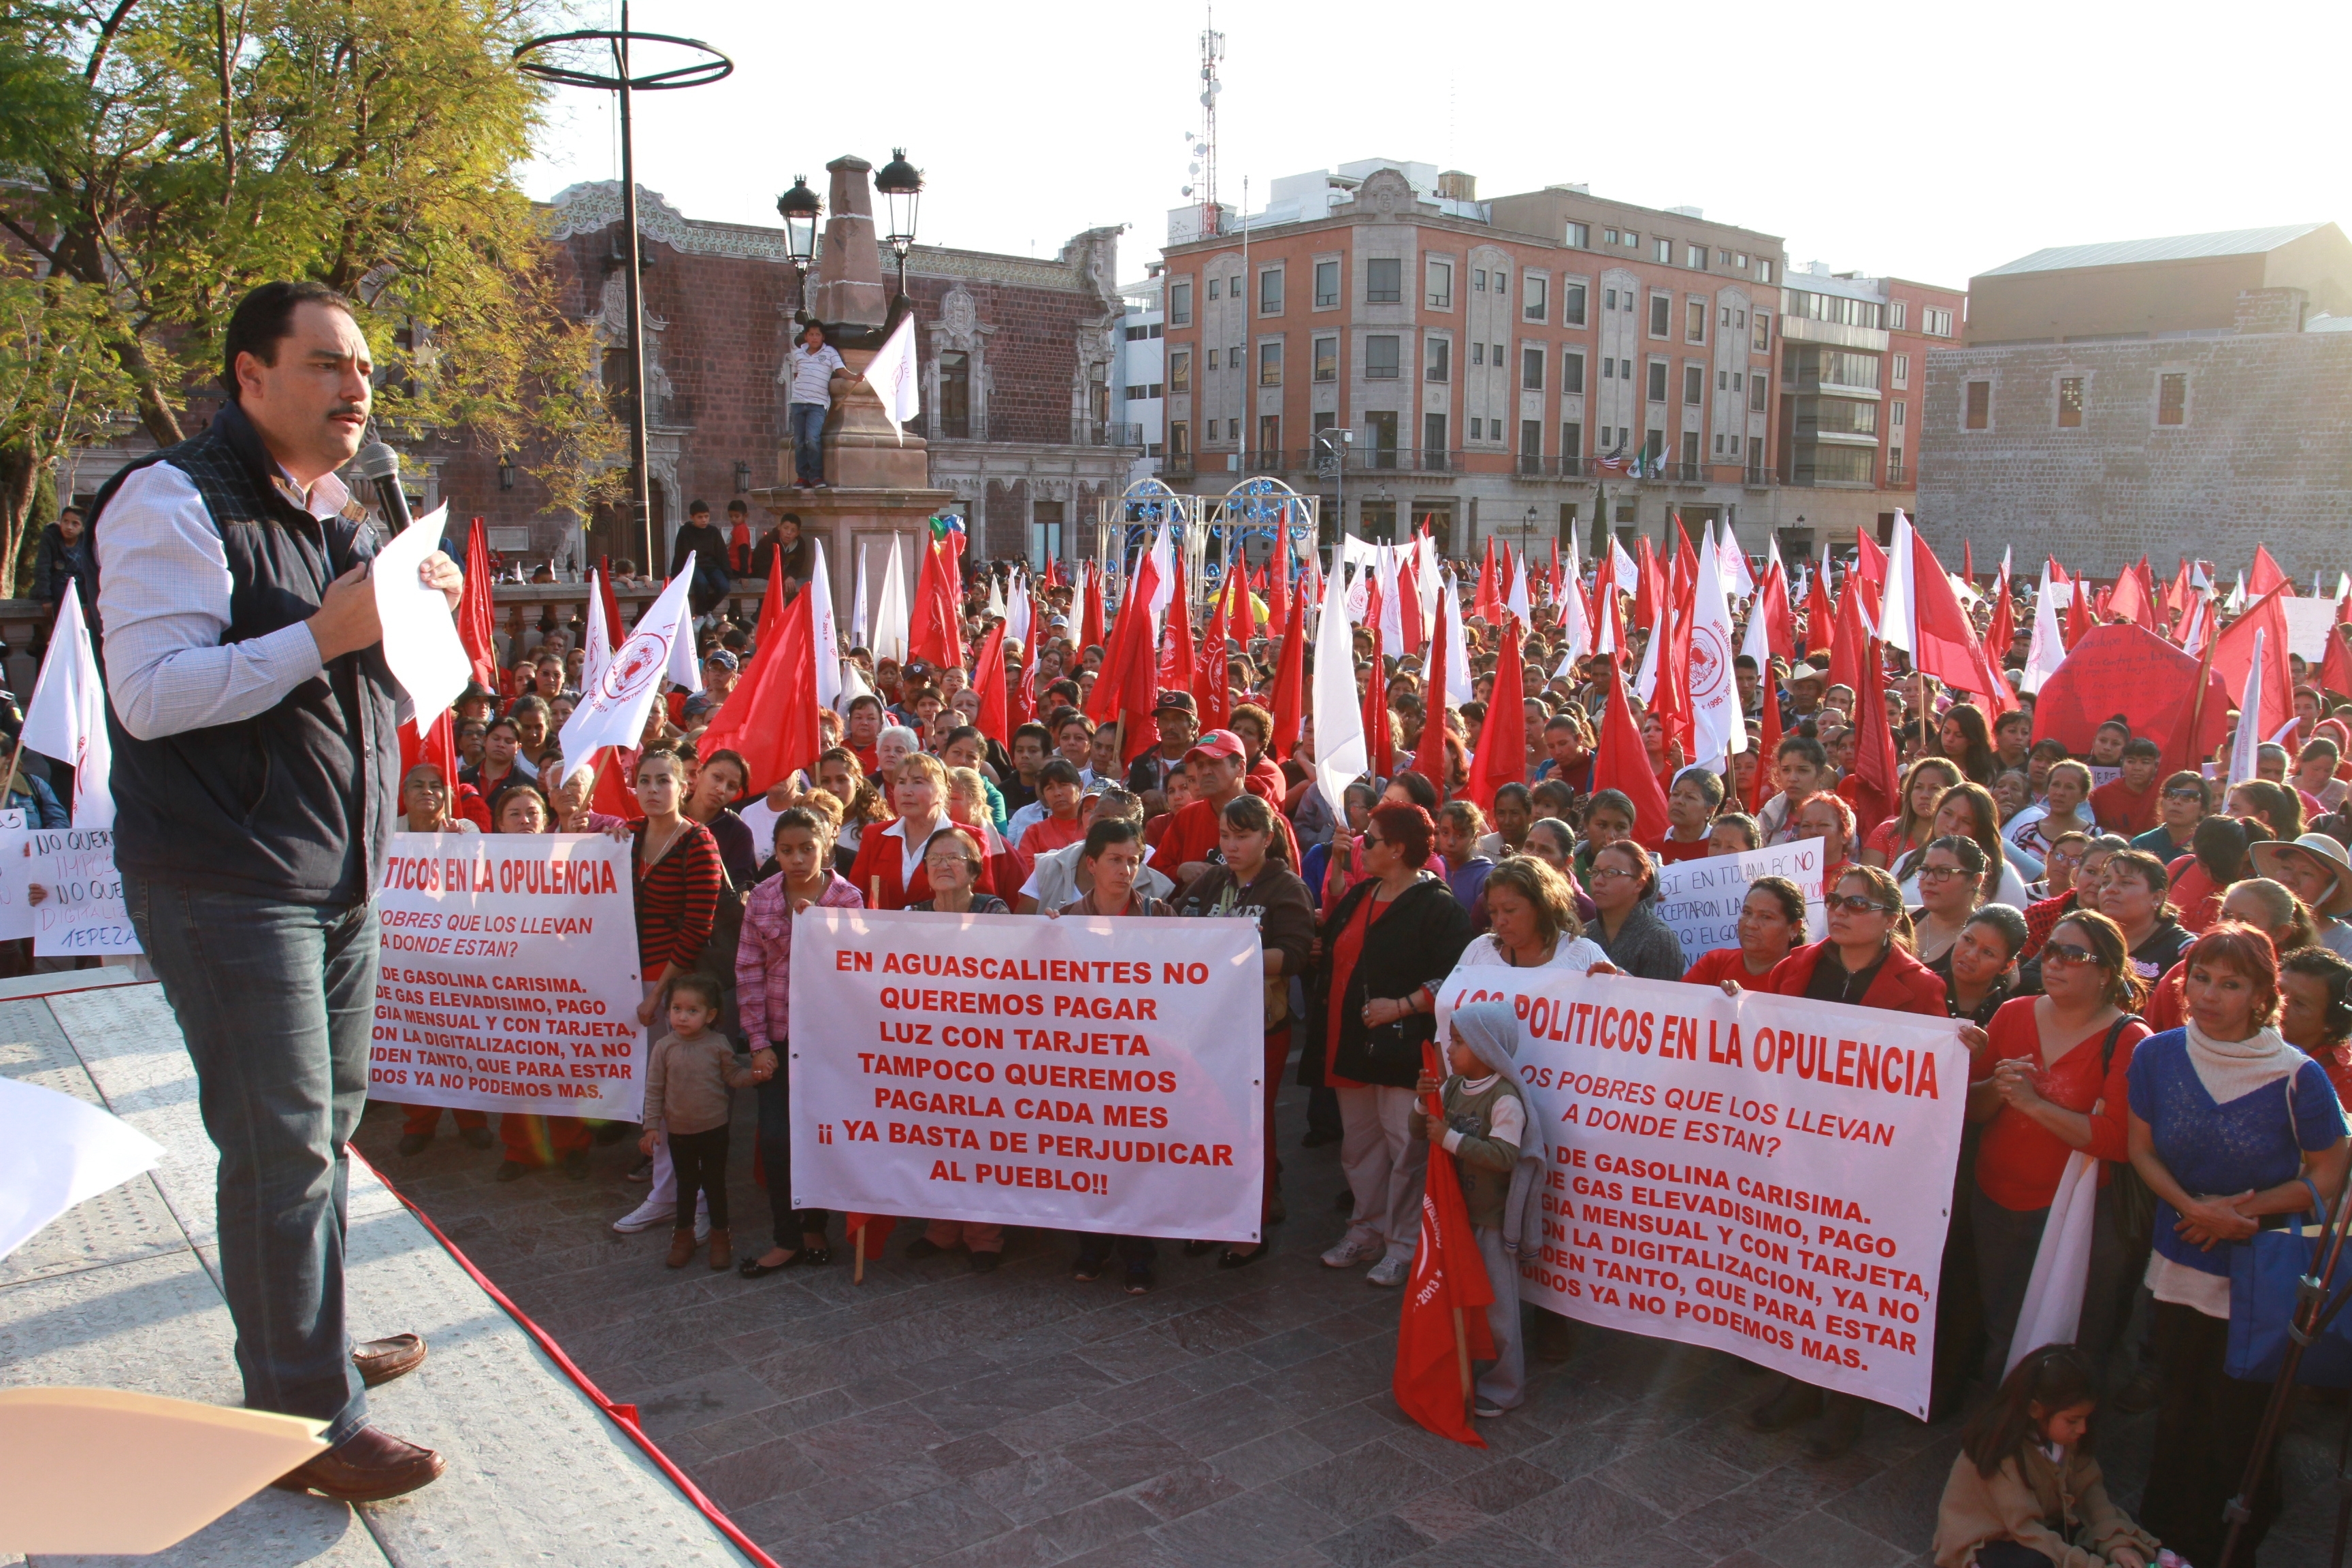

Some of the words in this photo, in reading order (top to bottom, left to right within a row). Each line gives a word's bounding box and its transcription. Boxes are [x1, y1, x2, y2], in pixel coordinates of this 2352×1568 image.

[36, 833, 61, 855] NO
[446, 859, 467, 892] EN
[472, 860, 495, 892] LA
[500, 860, 617, 895] OPULENCIA
[1660, 873, 1682, 896] SI
[1692, 869, 1714, 889] EN
[1795, 851, 1814, 873] NO
[56, 882, 84, 904] NO
[1656, 899, 1720, 921] ACEPTARON
[1726, 897, 1742, 916] LA
[378, 910, 442, 929] OBRES
[447, 914, 480, 932] QUE
[485, 915, 517, 933] LOS
[521, 917, 593, 934] LLEVAN
[380, 933, 389, 948] A
[393, 934, 452, 954] DONDE
[454, 938, 519, 958] ESTAN?
[382, 966, 400, 982] DE
[403, 969, 489, 989] GASOLINA
[492, 976, 587, 993] CARISIMA.
[836, 950, 873, 972] EN
[883, 952, 1152, 984] AGUASCALIENTES
[1164, 962, 1209, 985] NO
[395, 988, 425, 1005] GAS
[429, 992, 553, 1015] ELEVADISIMO,
[557, 999, 606, 1015] PAGO
[880, 987, 1044, 1016] QUEREMOS
[1054, 996, 1157, 1020] PAGAR
[404, 1009, 480, 1030] MENSUAL
[485, 1016, 497, 1030] Y
[503, 1017, 540, 1033] CON
[546, 1019, 637, 1038] TARJETA,
[880, 1022, 933, 1045] LUZ
[942, 1026, 1004, 1049] CON
[1014, 1029, 1150, 1056] TARJETA
[403, 1028, 422, 1044] LA
[425, 1032, 566, 1058] DIGITALIZACION,
[570, 1043, 596, 1057] YA
[602, 1043, 632, 1057] NO
[1514, 994, 1654, 1055] POLITICOS
[1659, 1015, 1698, 1061] EN
[1708, 1019, 1743, 1068] LA
[1753, 1027, 1940, 1100] OPULENCIA
[416, 1050, 473, 1073] TANTO,
[476, 1058, 511, 1075] QUE
[517, 1062, 565, 1077] PARA
[570, 1064, 632, 1079] ESTAR
[858, 1053, 995, 1083] TAMPOCO
[1005, 1064, 1177, 1093] QUEREMOS
[414, 1071, 435, 1087] YA
[440, 1073, 464, 1090] NO
[468, 1076, 552, 1097] PODEMOS
[558, 1083, 602, 1098] MAS.
[875, 1088, 1005, 1118] PAGARLA
[1015, 1098, 1094, 1124] CADA
[1104, 1105, 1169, 1128] MES
[1557, 1071, 1656, 1106] POBRES
[1664, 1088, 1723, 1113] QUE
[1729, 1096, 1778, 1126] LOS
[1785, 1107, 1895, 1147] LLEVAN
[843, 1120, 879, 1141] YA
[889, 1122, 980, 1149] BASTA
[990, 1131, 1028, 1153] DE
[1039, 1134, 1233, 1166] PERJUDICAR
[1561, 1103, 1578, 1124] A
[1585, 1107, 1678, 1139] DONDE
[1683, 1120, 1782, 1158] ESTAN?
[930, 1160, 966, 1181] AL
[976, 1164, 1108, 1195] PUEBLO!!
[1556, 1145, 1587, 1169] DE
[1594, 1153, 1731, 1190] GASOLINA
[1736, 1176, 1872, 1225] CARISIMA.
[1572, 1176, 1623, 1201] GAS
[1631, 1186, 1809, 1245] ELEVADISIMO,
[1818, 1225, 1897, 1258] PAGO
[1582, 1203, 1709, 1241] MENSUAL
[1717, 1225, 1734, 1245] Y
[1740, 1233, 1789, 1264] CON
[1797, 1249, 1930, 1302] TARJETA,
[1416, 1279, 1440, 1306] 2013
[1573, 1228, 1603, 1251] LA
[1611, 1235, 1823, 1307] DIGITALIZACION,
[1832, 1286, 1869, 1313] YA
[1878, 1296, 1920, 1324] NO
[1539, 1244, 1585, 1273] DEN
[1592, 1258, 1686, 1296] TANTO,
[1695, 1277, 1746, 1307] QUE
[1753, 1292, 1816, 1330] PARA
[1825, 1314, 1917, 1355] ESTAR
[1518, 1264, 1582, 1298] DIDOS
[1588, 1284, 1620, 1307] YA
[1629, 1292, 1666, 1315] NO
[1675, 1300, 1795, 1350] PODEMOS
[1801, 1337, 1869, 1371] MAS.
